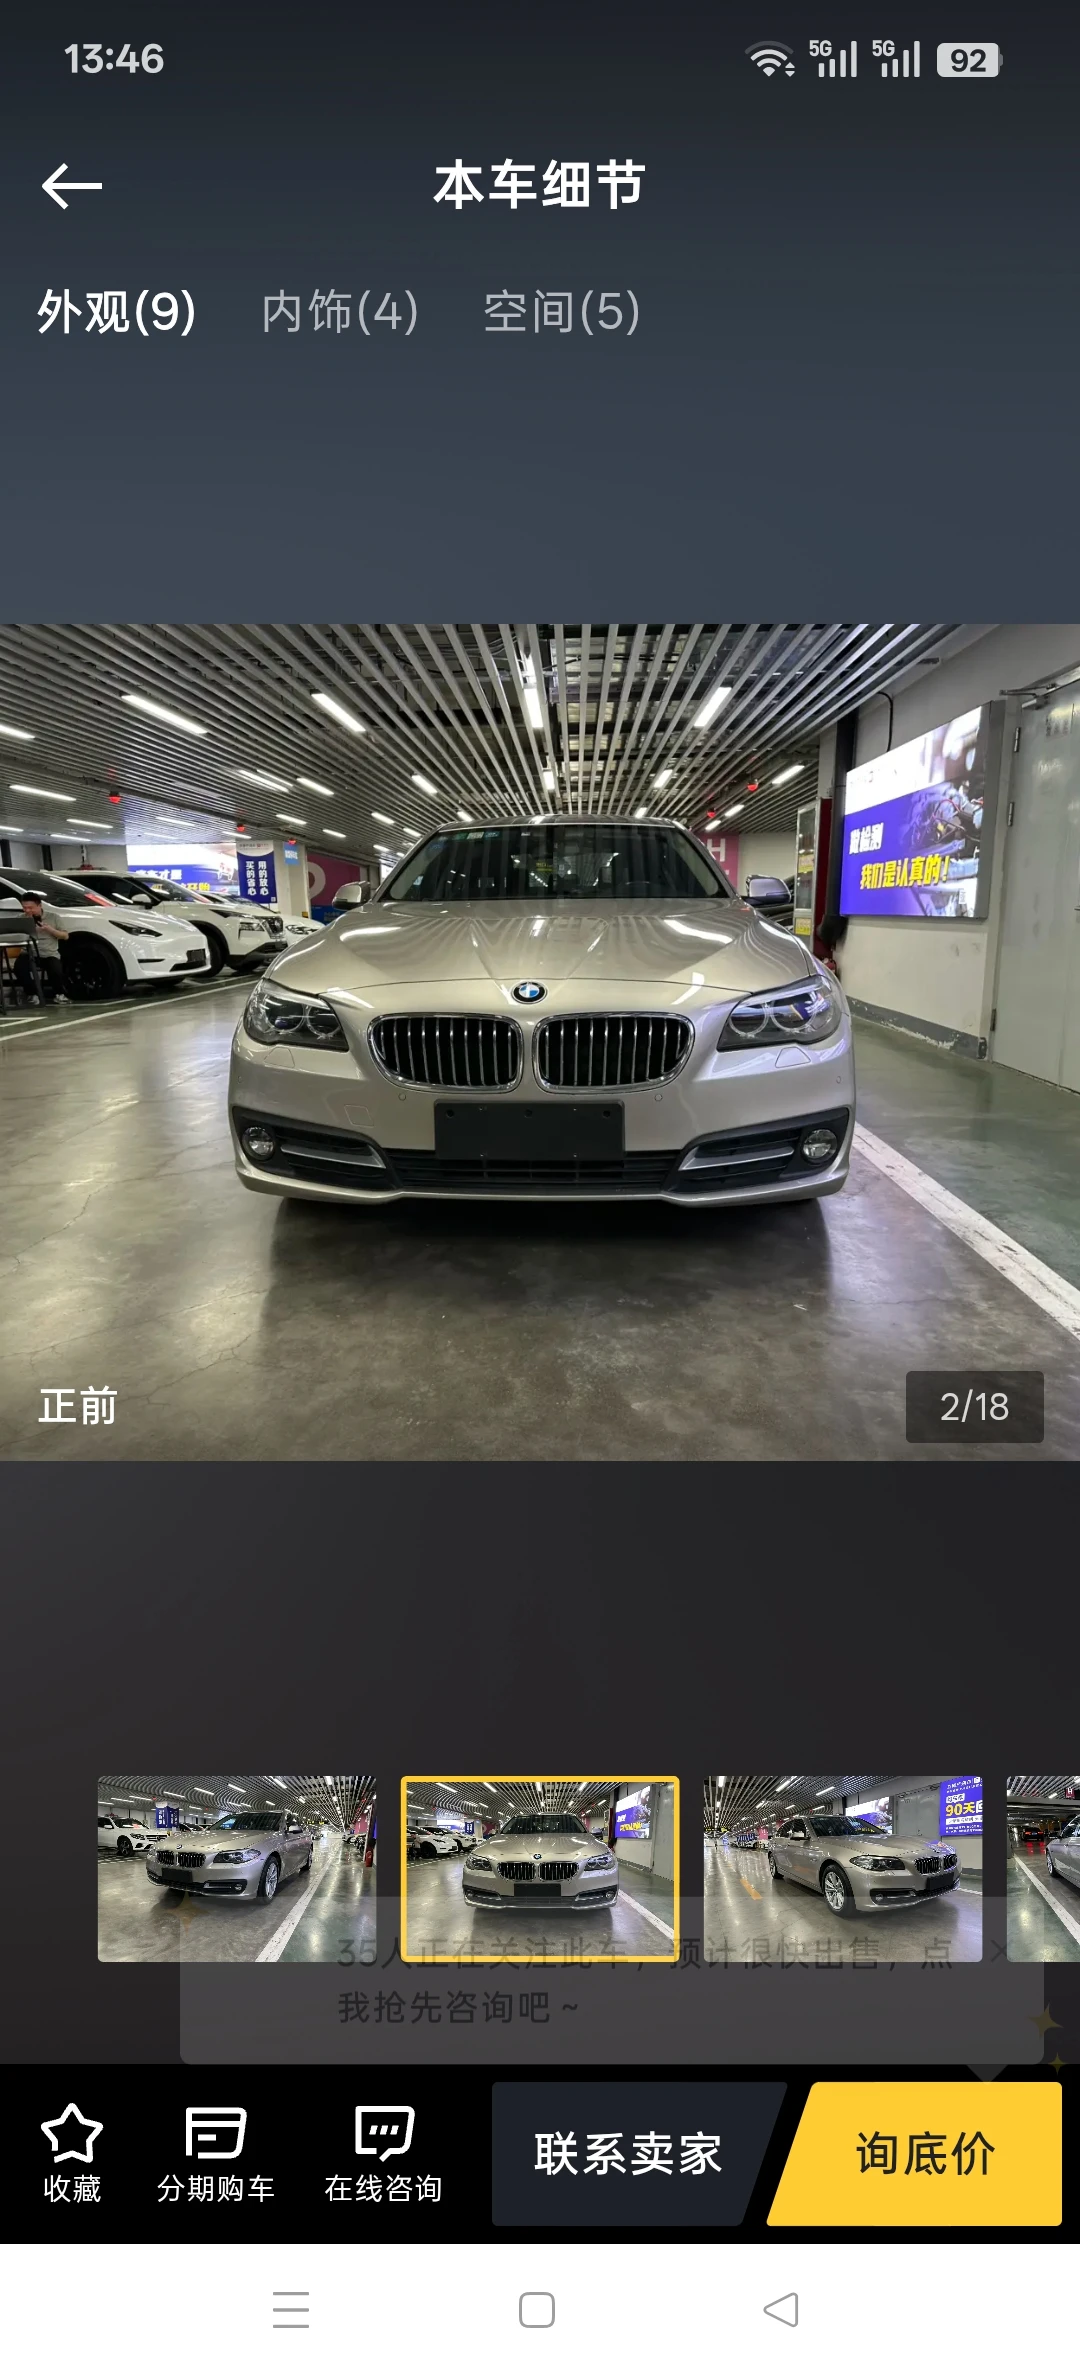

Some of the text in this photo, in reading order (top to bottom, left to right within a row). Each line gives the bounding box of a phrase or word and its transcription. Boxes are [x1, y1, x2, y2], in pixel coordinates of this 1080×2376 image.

[64, 43, 164, 74] 13:46
[809, 39, 833, 57] 5G
[872, 39, 896, 57] 5G
[950, 48, 987, 73] 92
[433, 158, 646, 210] 本车细节
[36, 288, 195, 337] 外观(9)
[263, 288, 418, 336] 内饰(4)
[484, 288, 639, 336] 空间(5)
[707, 838, 726, 862] H
[245, 861, 257, 896] 买的省心
[258, 861, 269, 896] 用的放心
[860, 853, 950, 890] 我们是认真的！
[534, 2130, 723, 2176] 联系卖家
[856, 2130, 996, 2176] 询底价
[43, 2174, 102, 2204] 收藏
[157, 2173, 275, 2203] 分期购车
[324, 2173, 442, 2203] 在线咨询
